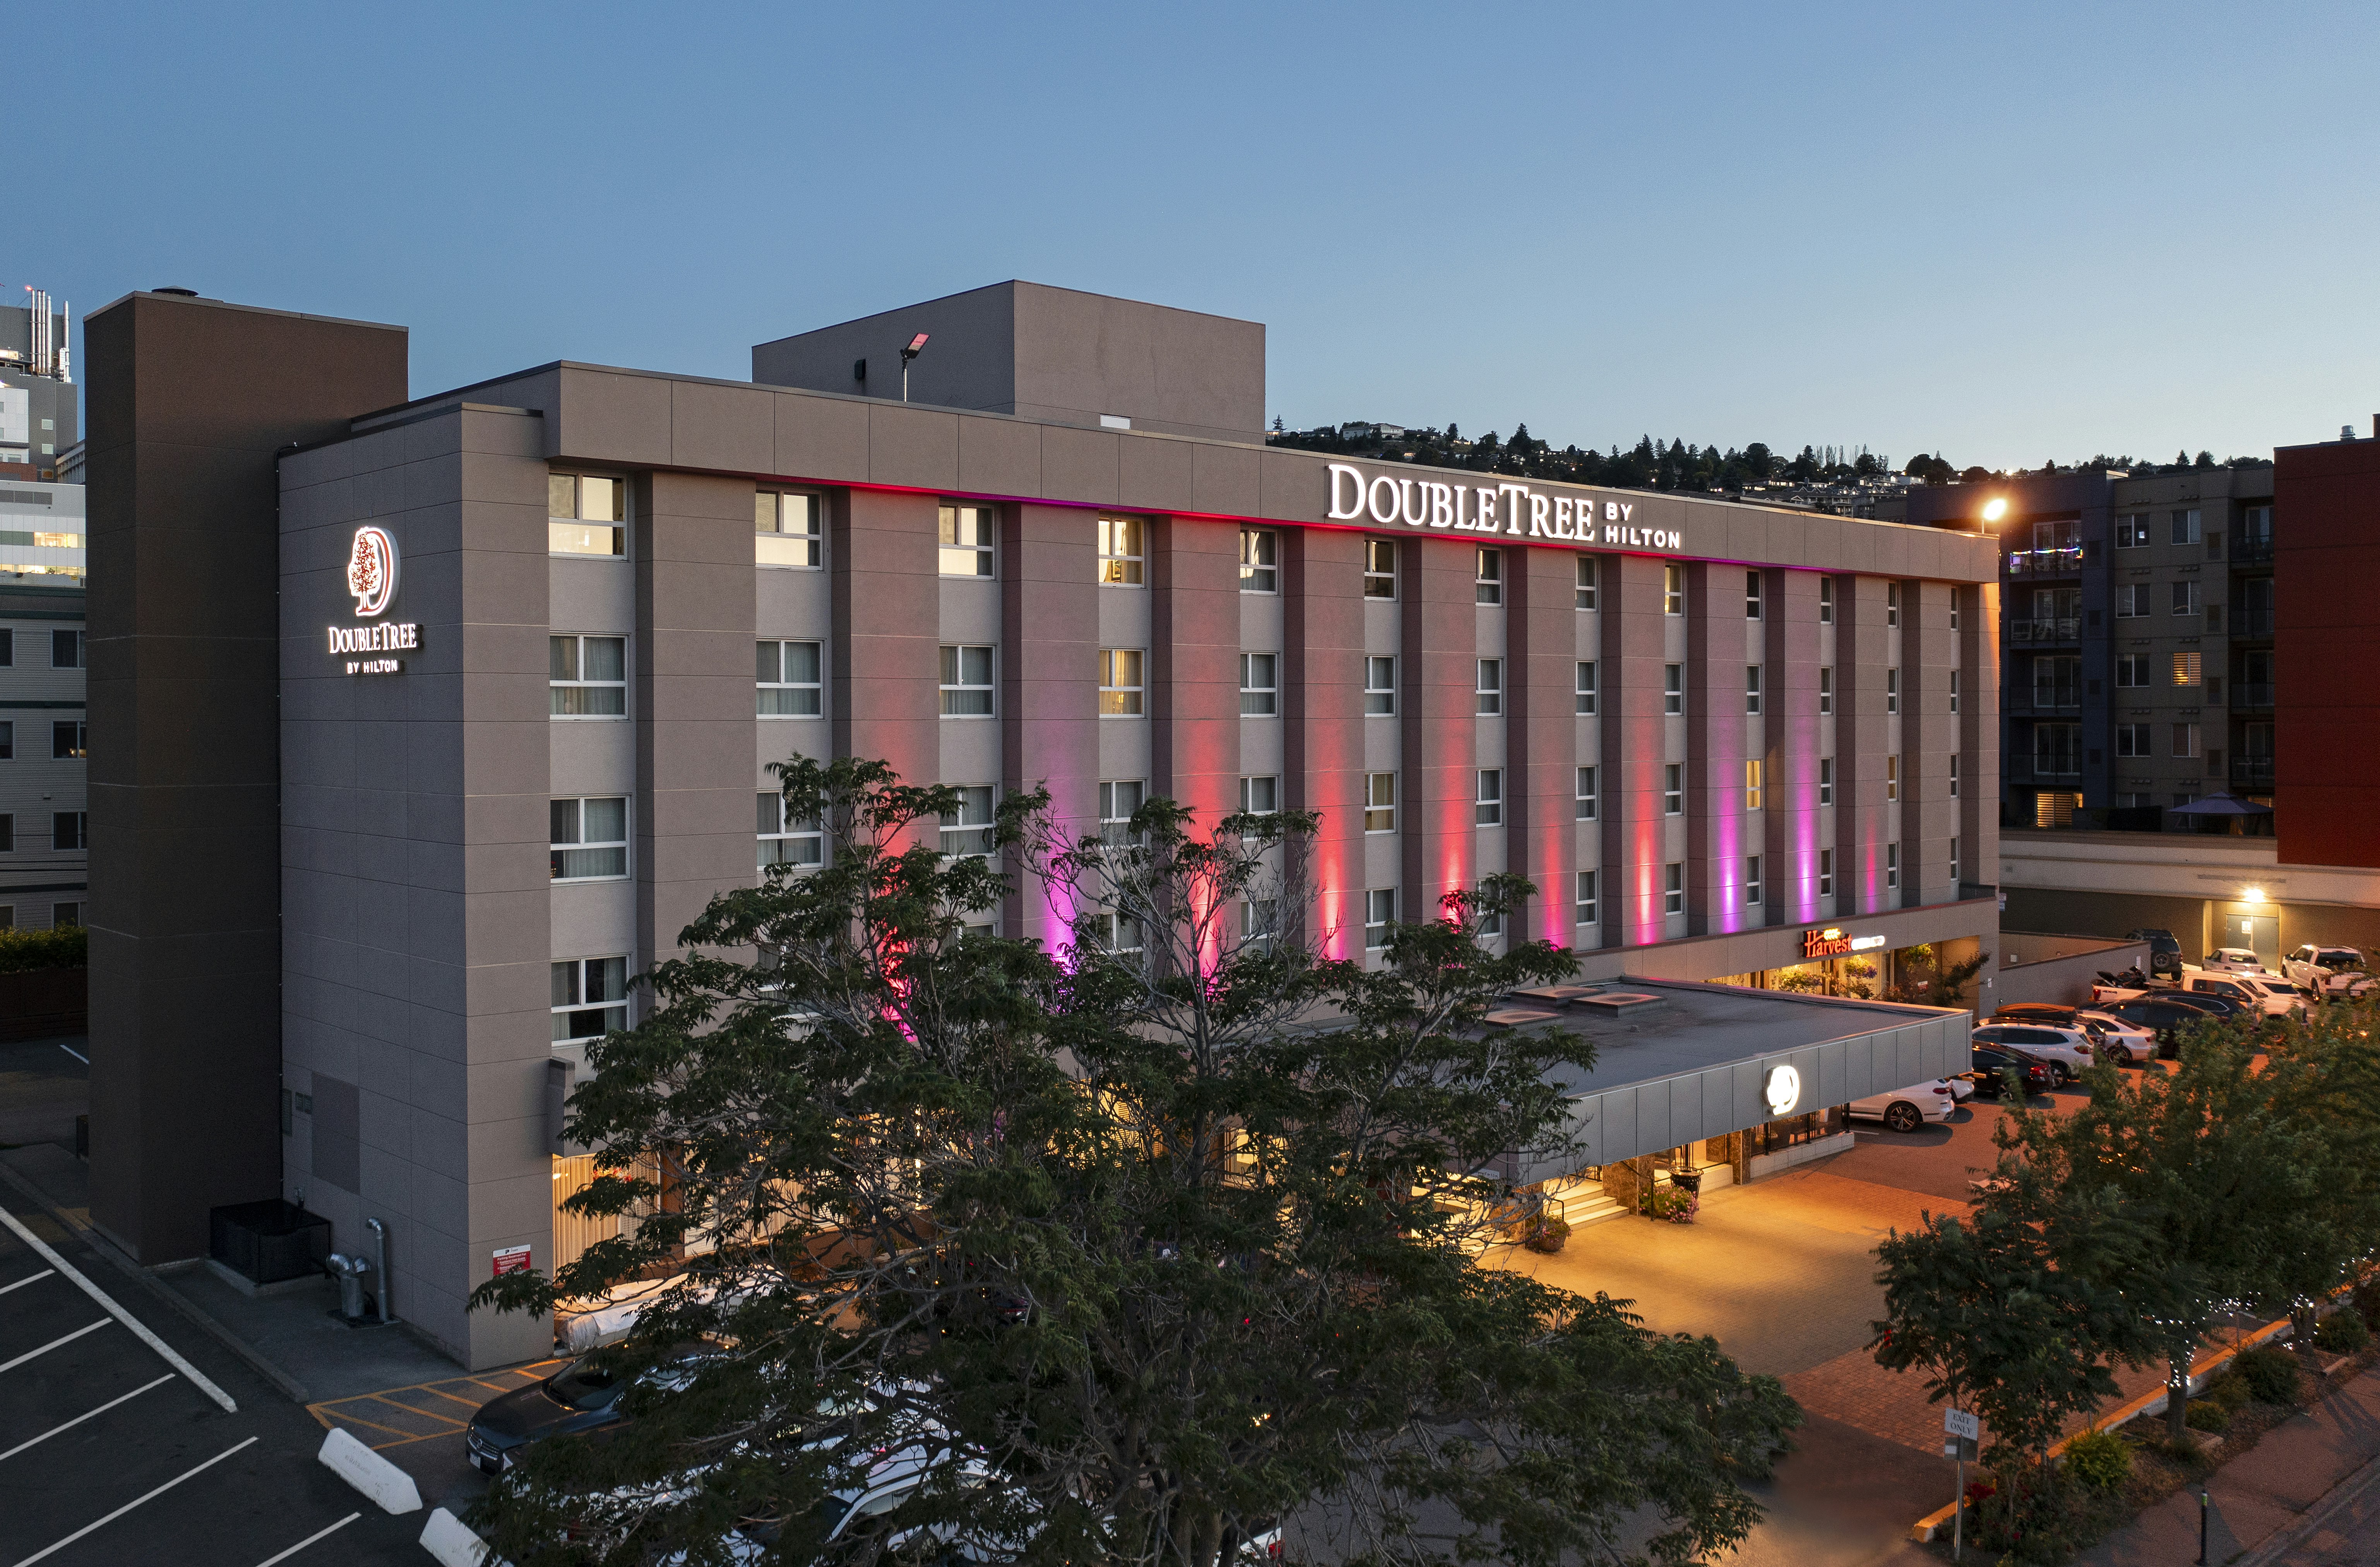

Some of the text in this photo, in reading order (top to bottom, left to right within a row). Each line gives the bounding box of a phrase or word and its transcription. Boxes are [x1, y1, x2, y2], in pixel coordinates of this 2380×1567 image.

[1606, 502, 1632, 521] BY
[1606, 526, 1681, 549] HILTON
[347, 659, 397, 674] BY HILTON
[1804, 929, 1853, 958] Harvest
[1953, 1413, 1971, 1425] EXIT
[1950, 1422, 1972, 1435] ONLY
